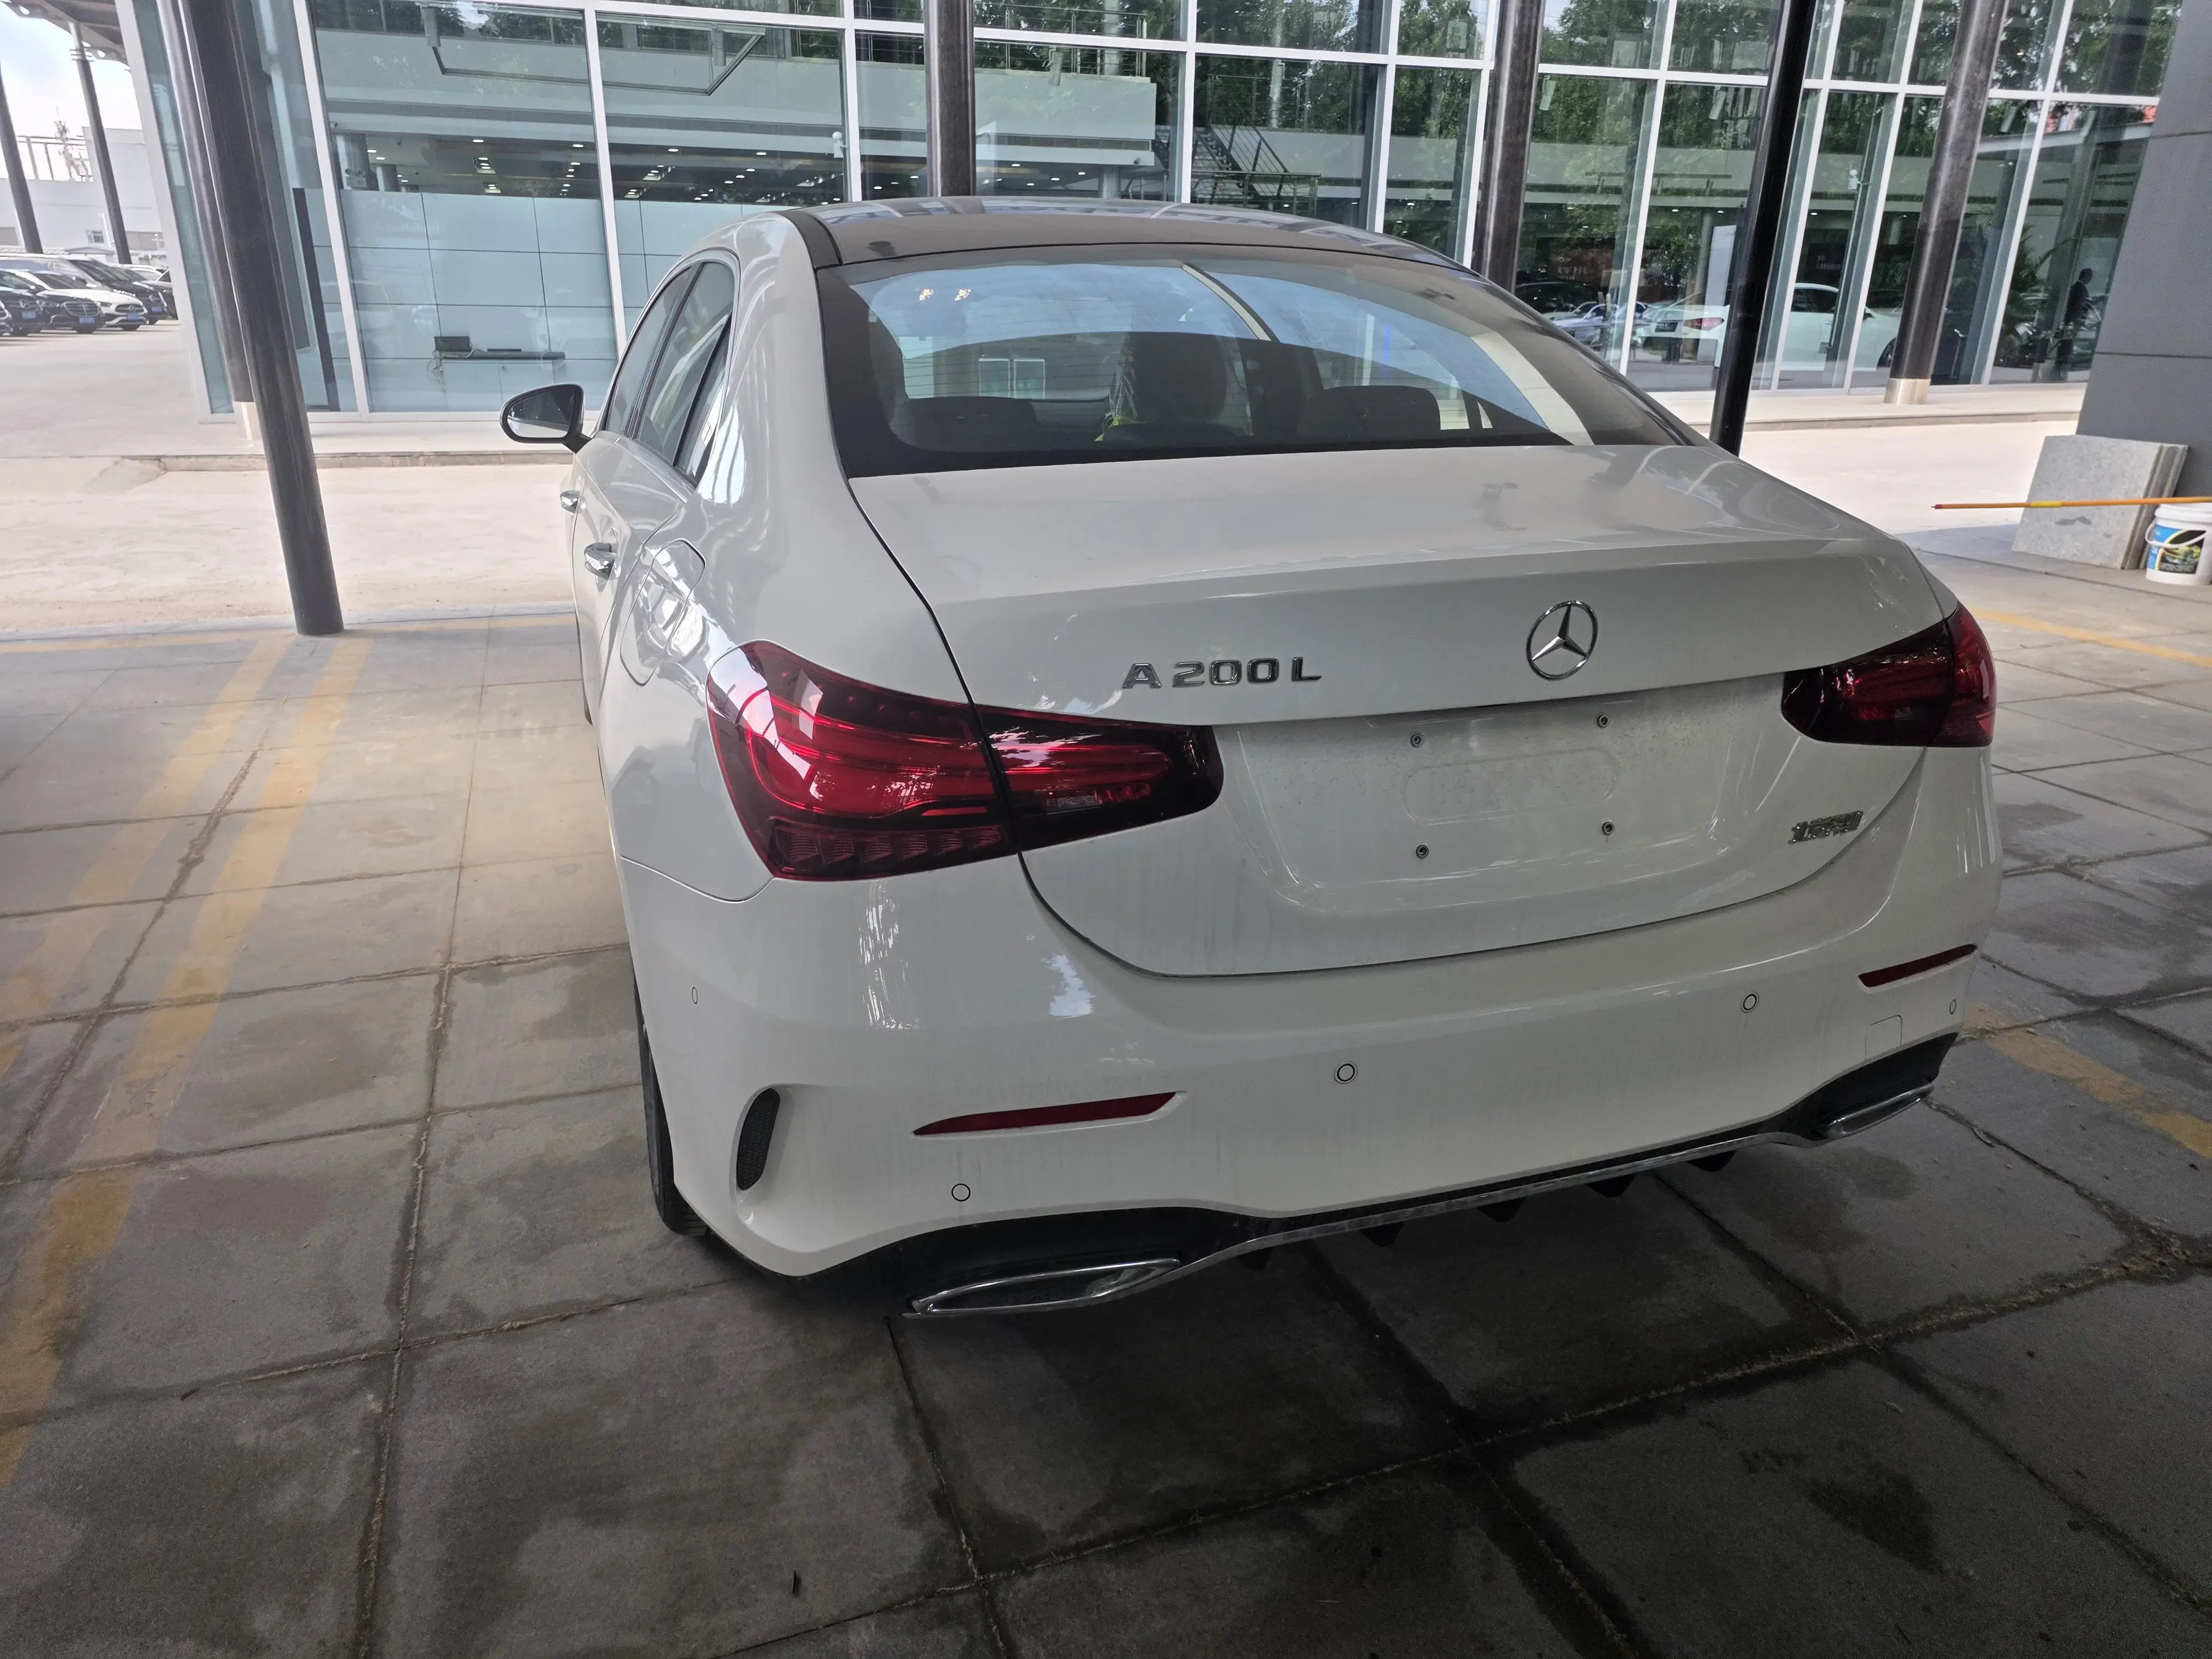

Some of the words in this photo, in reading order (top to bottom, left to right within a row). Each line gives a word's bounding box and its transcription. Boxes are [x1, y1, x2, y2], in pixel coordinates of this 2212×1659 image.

[1121, 662, 1162, 689] A
[1172, 658, 1280, 688] 200
[1291, 656, 1323, 682] L
